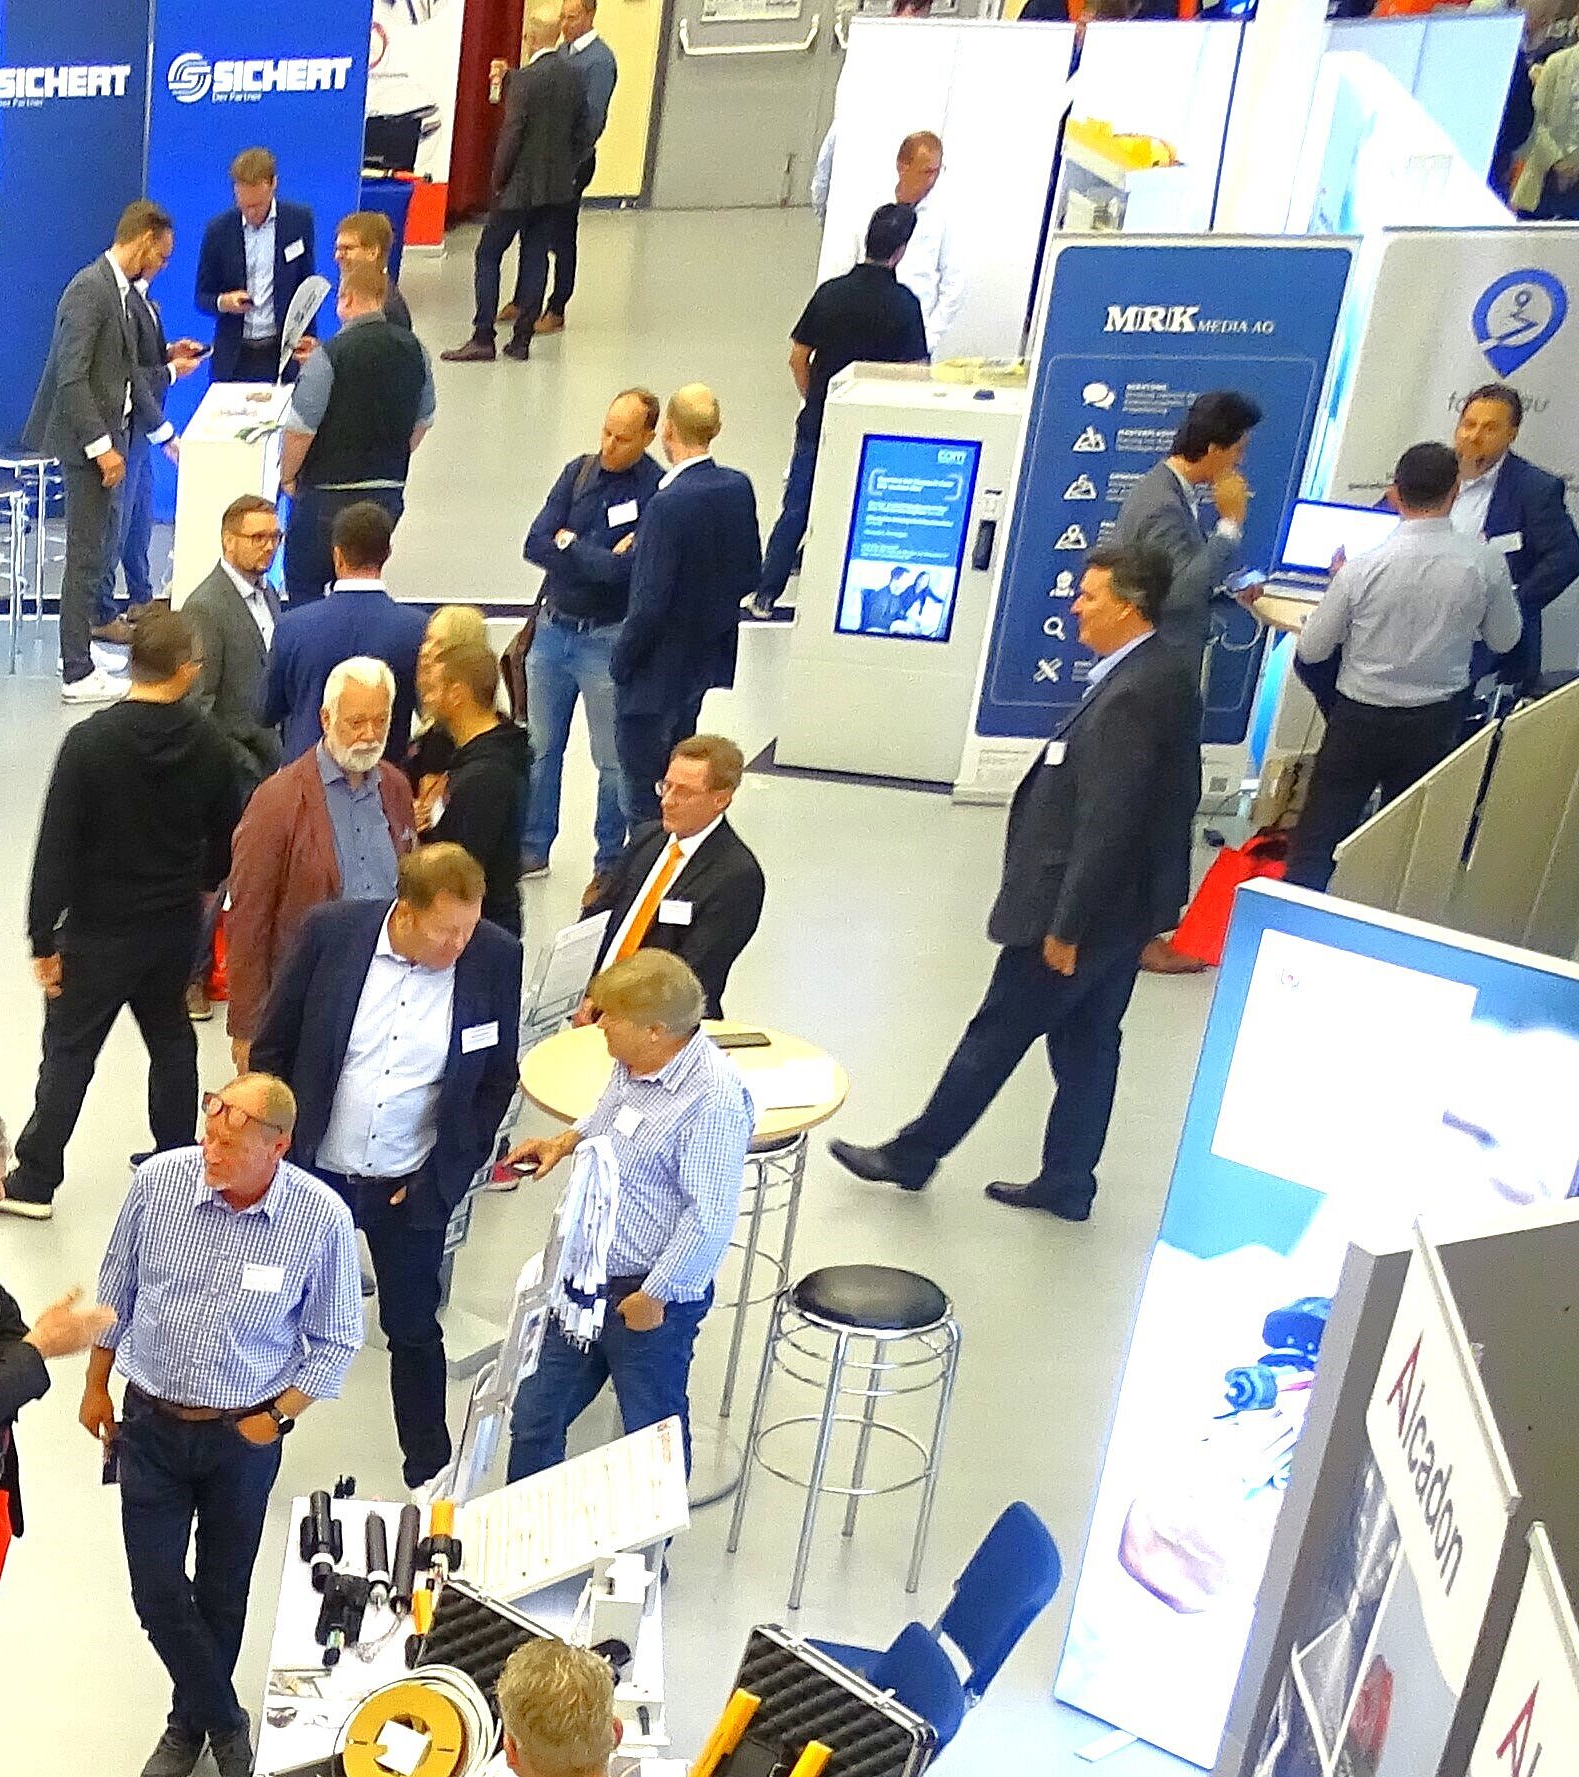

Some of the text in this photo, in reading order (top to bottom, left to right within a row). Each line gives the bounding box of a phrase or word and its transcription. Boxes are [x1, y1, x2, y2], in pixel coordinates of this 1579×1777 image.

[213, 57, 352, 93] SICHERT
[1104, 304, 1200, 334] MRK
[1198, 319, 1247, 334] MEDIA
[1385, 1329, 1463, 1598] Alcadon
